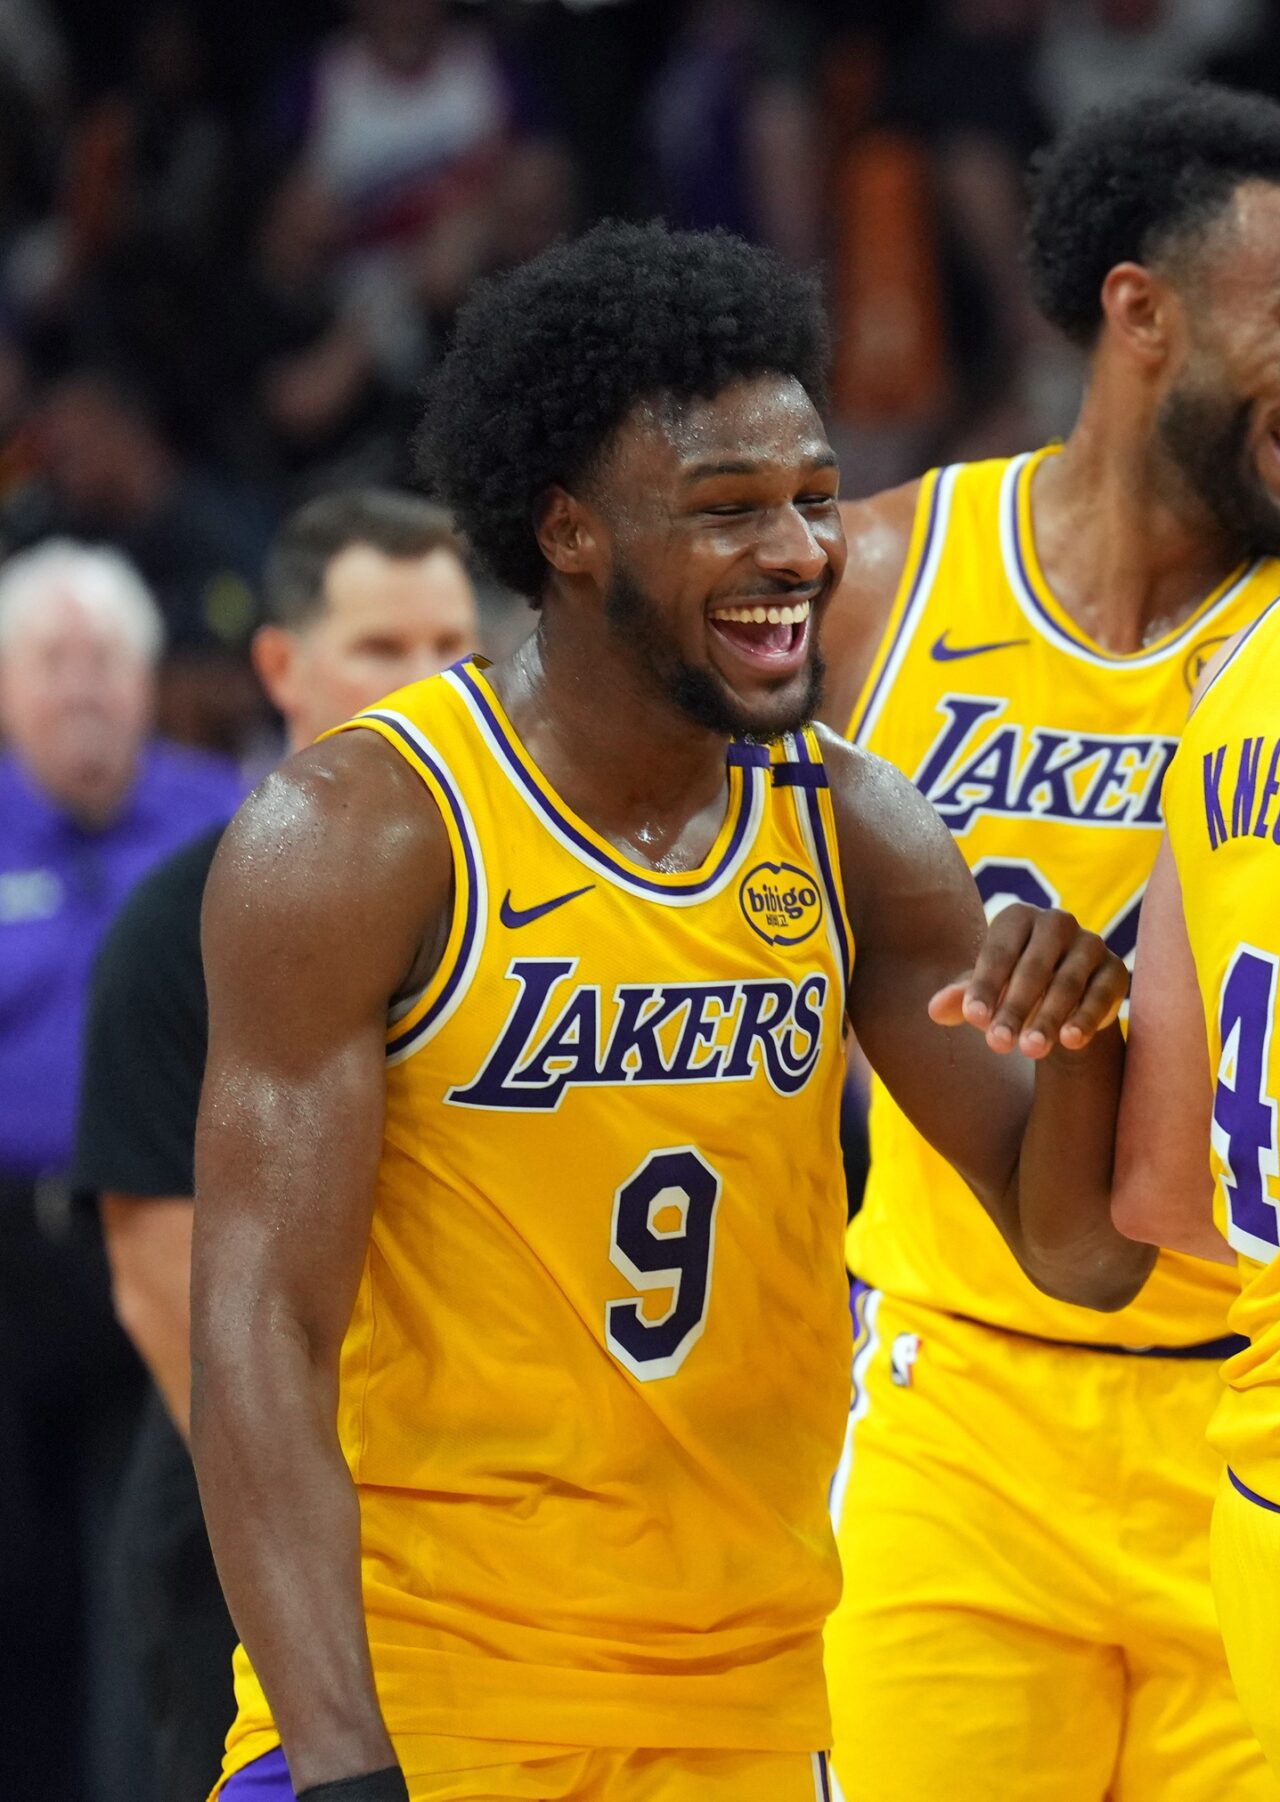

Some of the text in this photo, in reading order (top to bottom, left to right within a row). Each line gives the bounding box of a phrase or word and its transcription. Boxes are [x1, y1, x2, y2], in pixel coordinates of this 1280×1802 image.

[912, 692, 1180, 837] LAKE
[747, 883, 817, 920] bibigo
[443, 956, 829, 1113] LAKERS
[604, 1144, 723, 1383] 9
